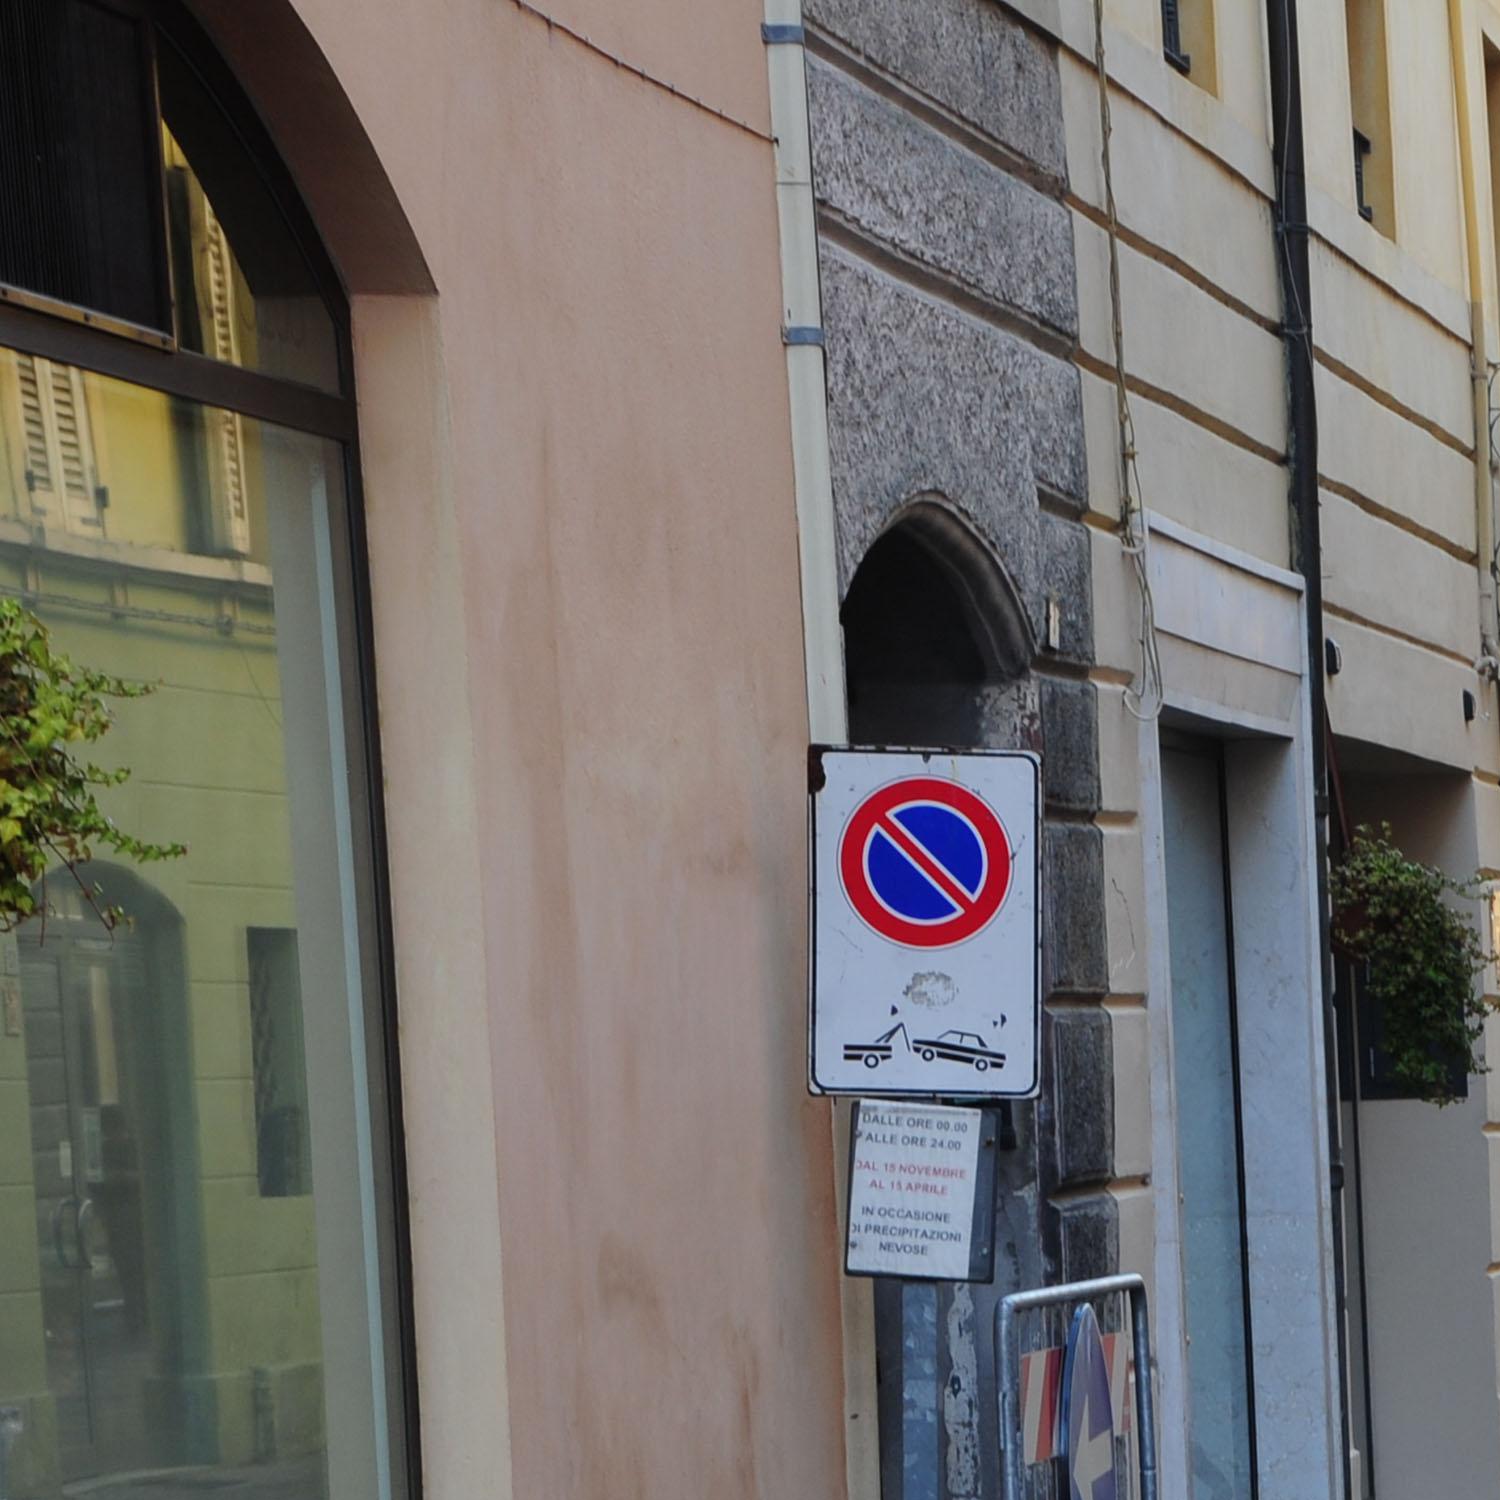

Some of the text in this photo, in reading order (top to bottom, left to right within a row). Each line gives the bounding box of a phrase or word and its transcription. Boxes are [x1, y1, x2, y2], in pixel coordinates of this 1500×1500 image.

[862, 1112, 968, 1133] DALLE ORE 00.00
[865, 1132, 961, 1151] ALLE ORE 24.00
[898, 1163, 966, 1179] NOVEMBRE
[869, 1180, 948, 1196] AL 15 APRILE
[861, 1205, 951, 1223] IN OCCASIONE
[864, 1223, 962, 1242] PRECIPITAZIONI
[879, 1242, 928, 1256] NEVOSE
